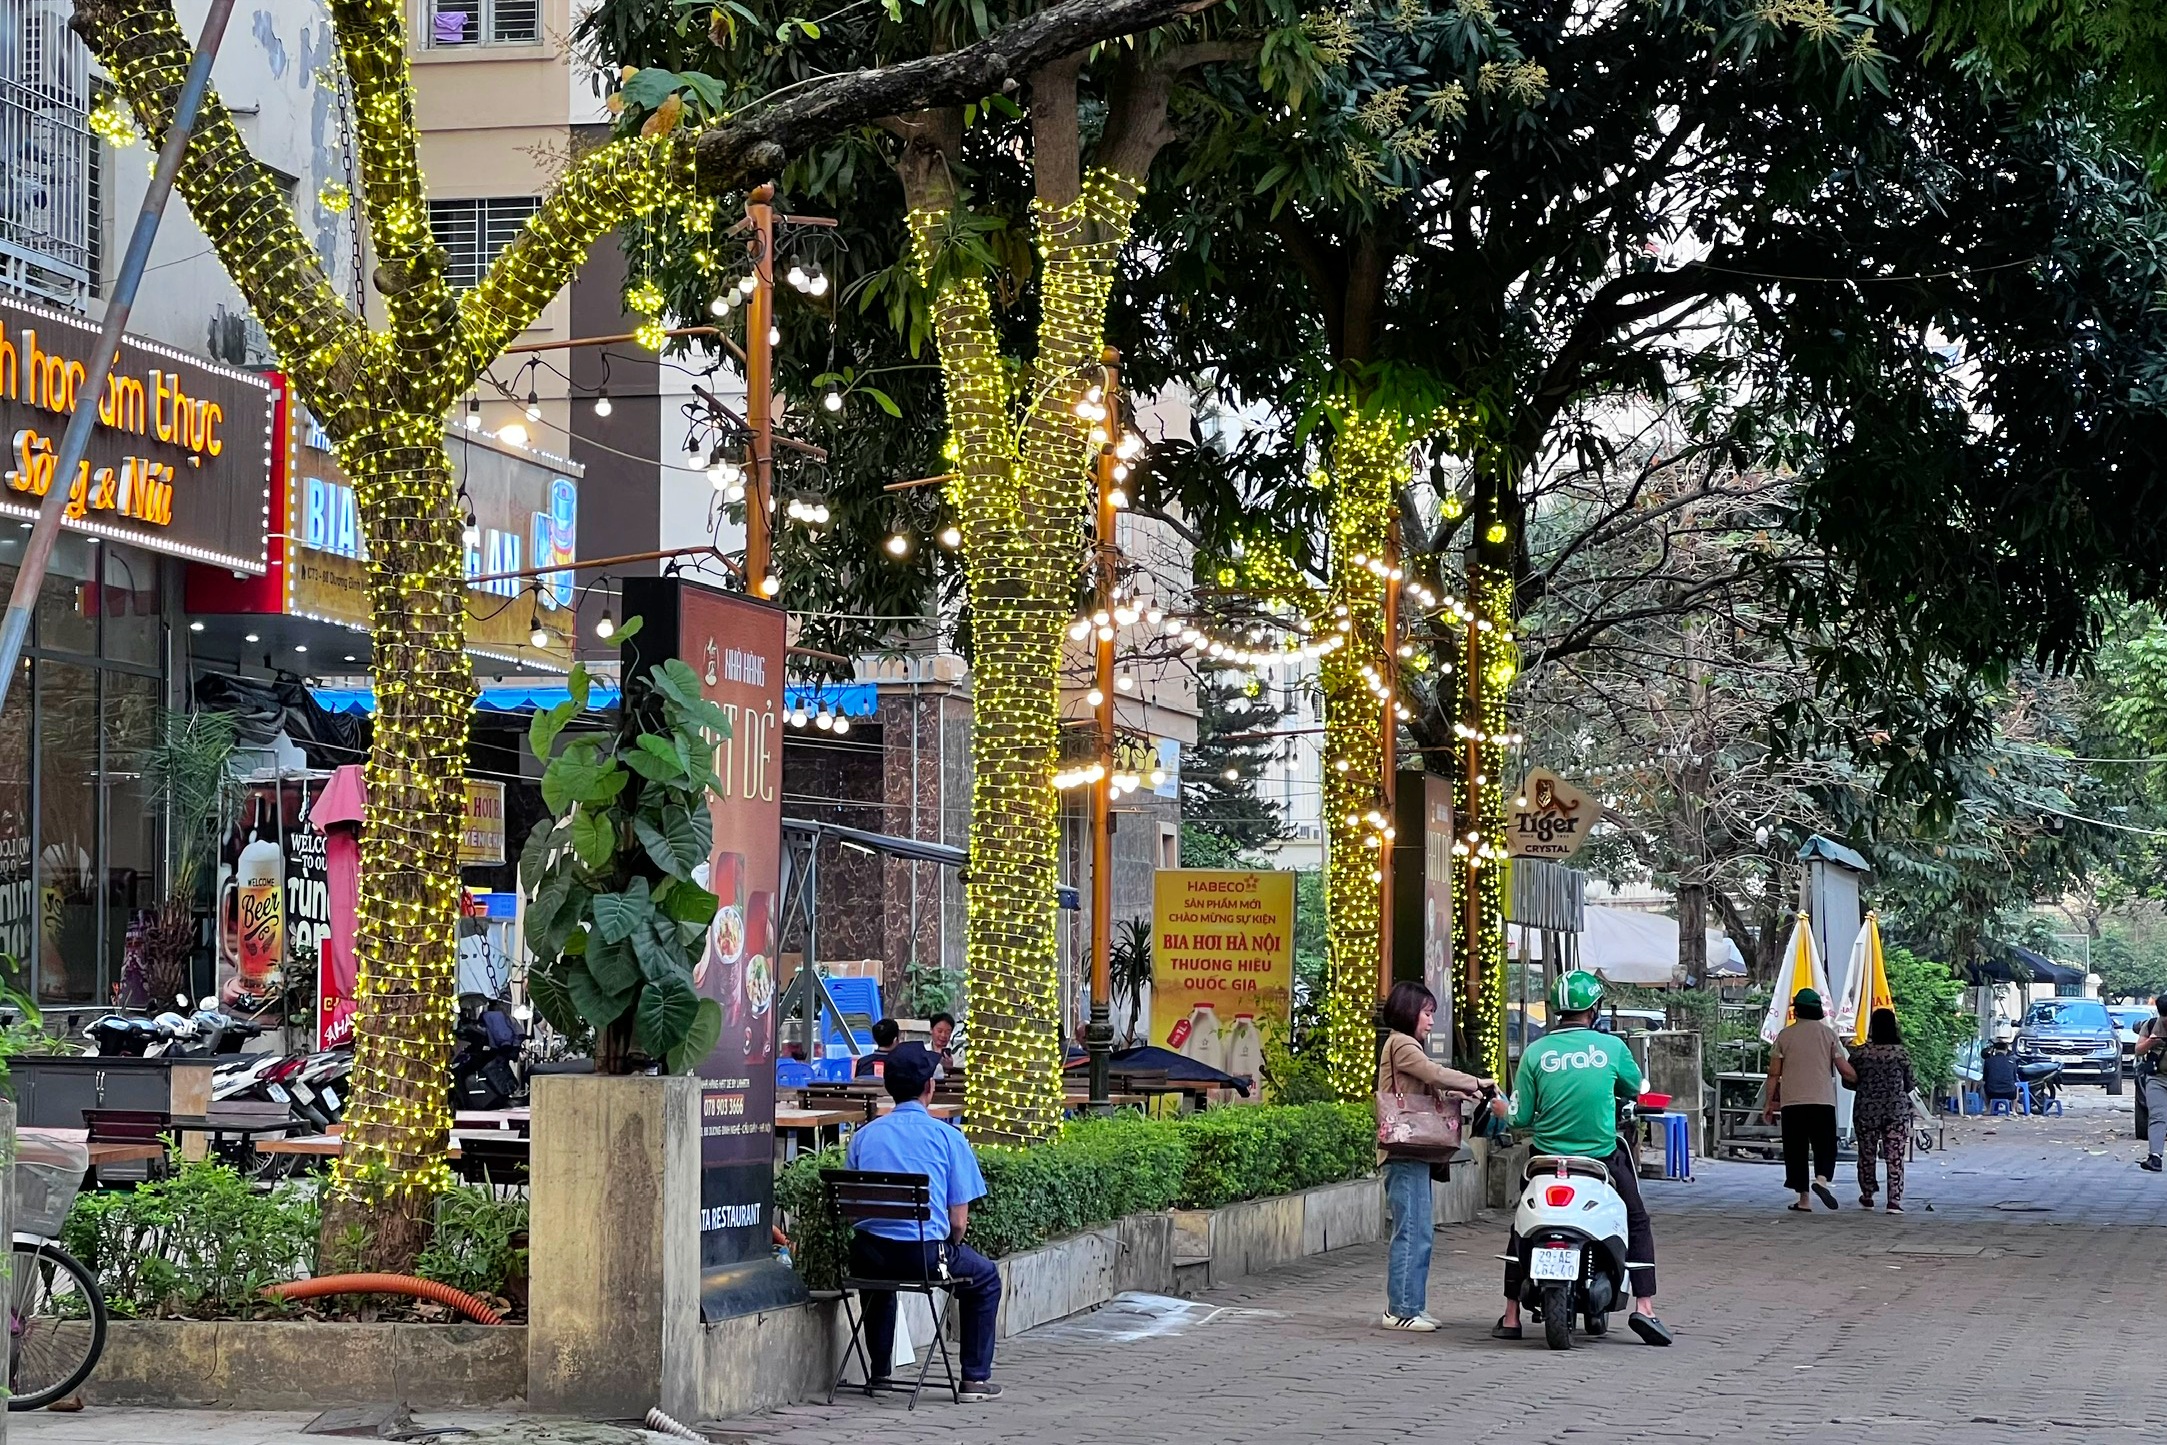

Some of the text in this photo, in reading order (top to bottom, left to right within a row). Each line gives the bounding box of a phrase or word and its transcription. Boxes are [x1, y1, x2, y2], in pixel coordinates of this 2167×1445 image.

[149, 369, 223, 468] thực
[8, 430, 174, 526] Sôg & Núi
[303, 478, 358, 560] BIA
[725, 646, 765, 688] NHÀ HÀNG
[461, 826, 486, 848] YÊN
[1515, 810, 1580, 842] Tiger
[1525, 844, 1570, 853] CRYSTAL
[247, 877, 275, 888] WELCOME
[1187, 881, 1245, 893] HABECO
[241, 891, 281, 929] Beer
[1168, 912, 1199, 923] CHÀO
[1200, 912, 1234, 924] MỪNG
[1252, 914, 1276, 925] KIỆN
[1163, 931, 1281, 956] BIA HƠI HÀ NỘI
[1170, 957, 1233, 972] THƯƠNG
[1231, 978, 1257, 991] GIA
[1540, 1044, 1608, 1073] Grab
[703, 1096, 744, 1117] 078 903 3666
[700, 1202, 761, 1232] TA RESTAURANT
[1538, 1250, 1572, 1264] 29-AE
